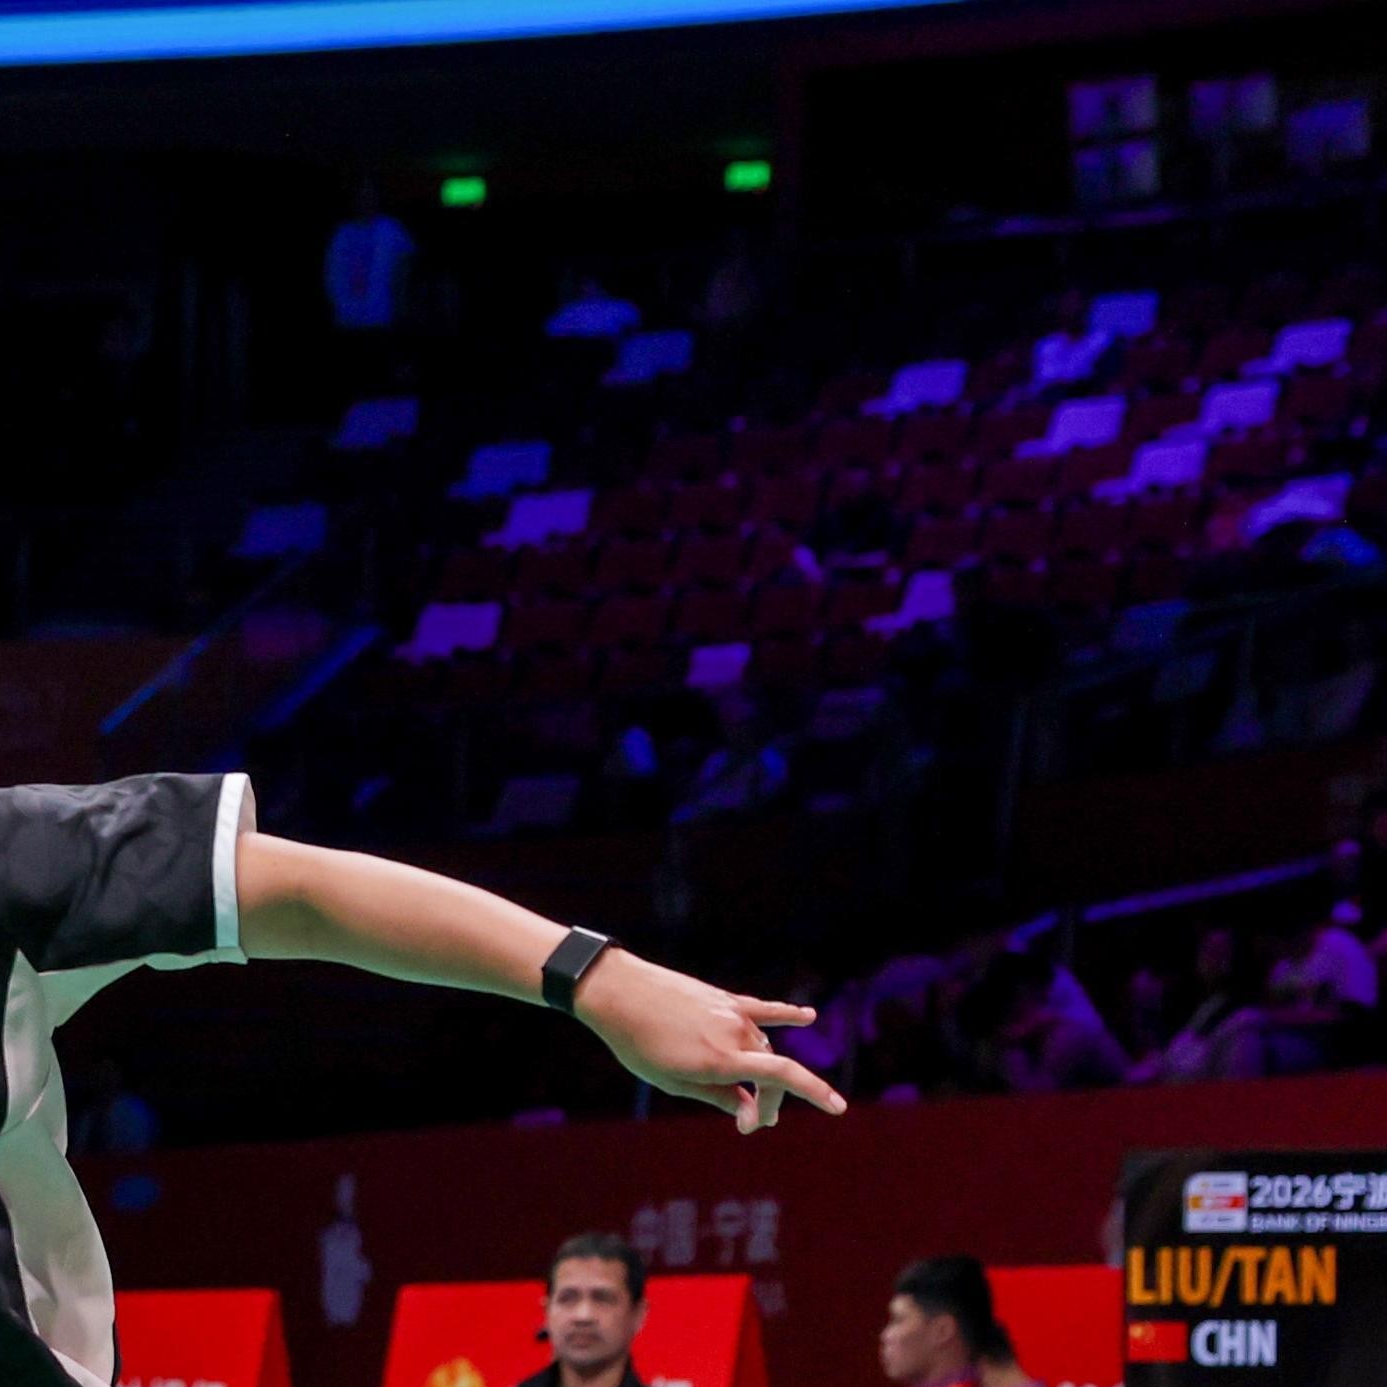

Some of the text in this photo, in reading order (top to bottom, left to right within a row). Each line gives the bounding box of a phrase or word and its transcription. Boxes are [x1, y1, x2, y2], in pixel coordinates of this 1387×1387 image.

[1249, 1213, 1302, 1234] BANK
[1305, 1213, 1329, 1233] OF
[1127, 1245, 1337, 1307] LIU/TAN
[1190, 1319, 1277, 1367] CHN
